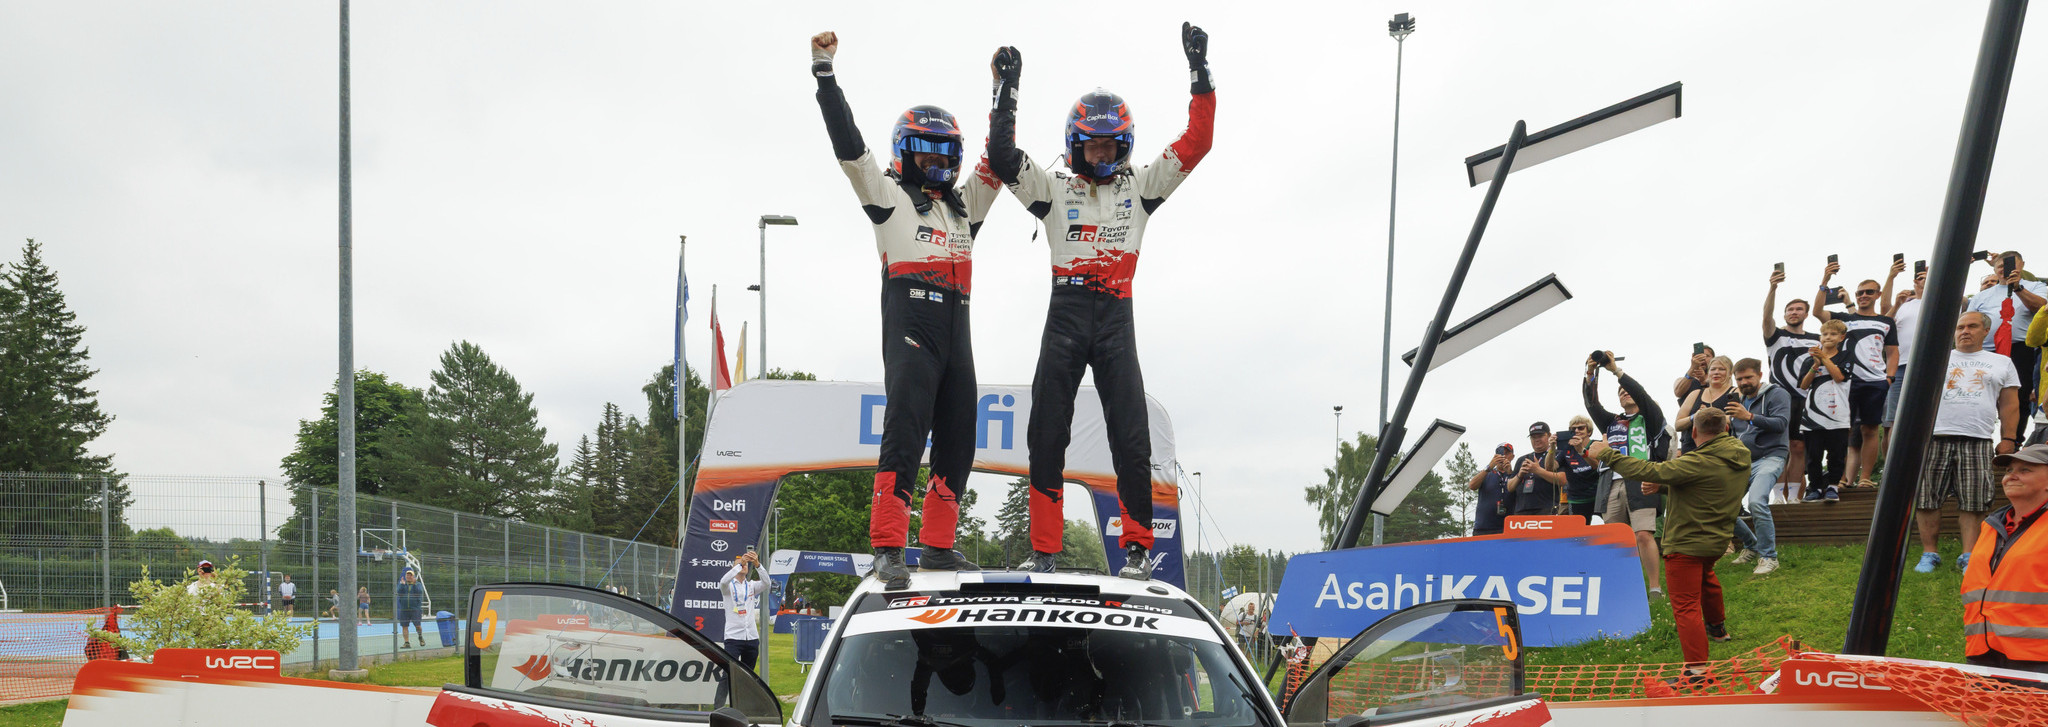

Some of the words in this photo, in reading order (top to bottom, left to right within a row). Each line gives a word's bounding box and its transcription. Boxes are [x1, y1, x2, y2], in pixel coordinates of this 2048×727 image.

[1107, 113, 1119, 121] Box
[1101, 225, 1130, 233] TOYOTA
[915, 230, 947, 247] GR
[1067, 230, 1096, 243] GR
[909, 289, 926, 298] OMP
[859, 393, 1016, 450] Dfi
[1621, 426, 1646, 454] 243
[716, 450, 742, 458] WRC
[713, 500, 746, 512] Delfi
[1509, 520, 1553, 530] WRC
[695, 581, 720, 589] FORU
[935, 596, 1019, 605] TOYOTA
[1020, 595, 1101, 606] GAZOO
[1104, 600, 1174, 615] Racing
[473, 591, 503, 649] 5
[557, 618, 587, 626] WRC
[694, 616, 705, 631] 3
[1493, 607, 1519, 661] 5
[206, 655, 275, 669] WRC
[1795, 669, 1892, 691] WRC
